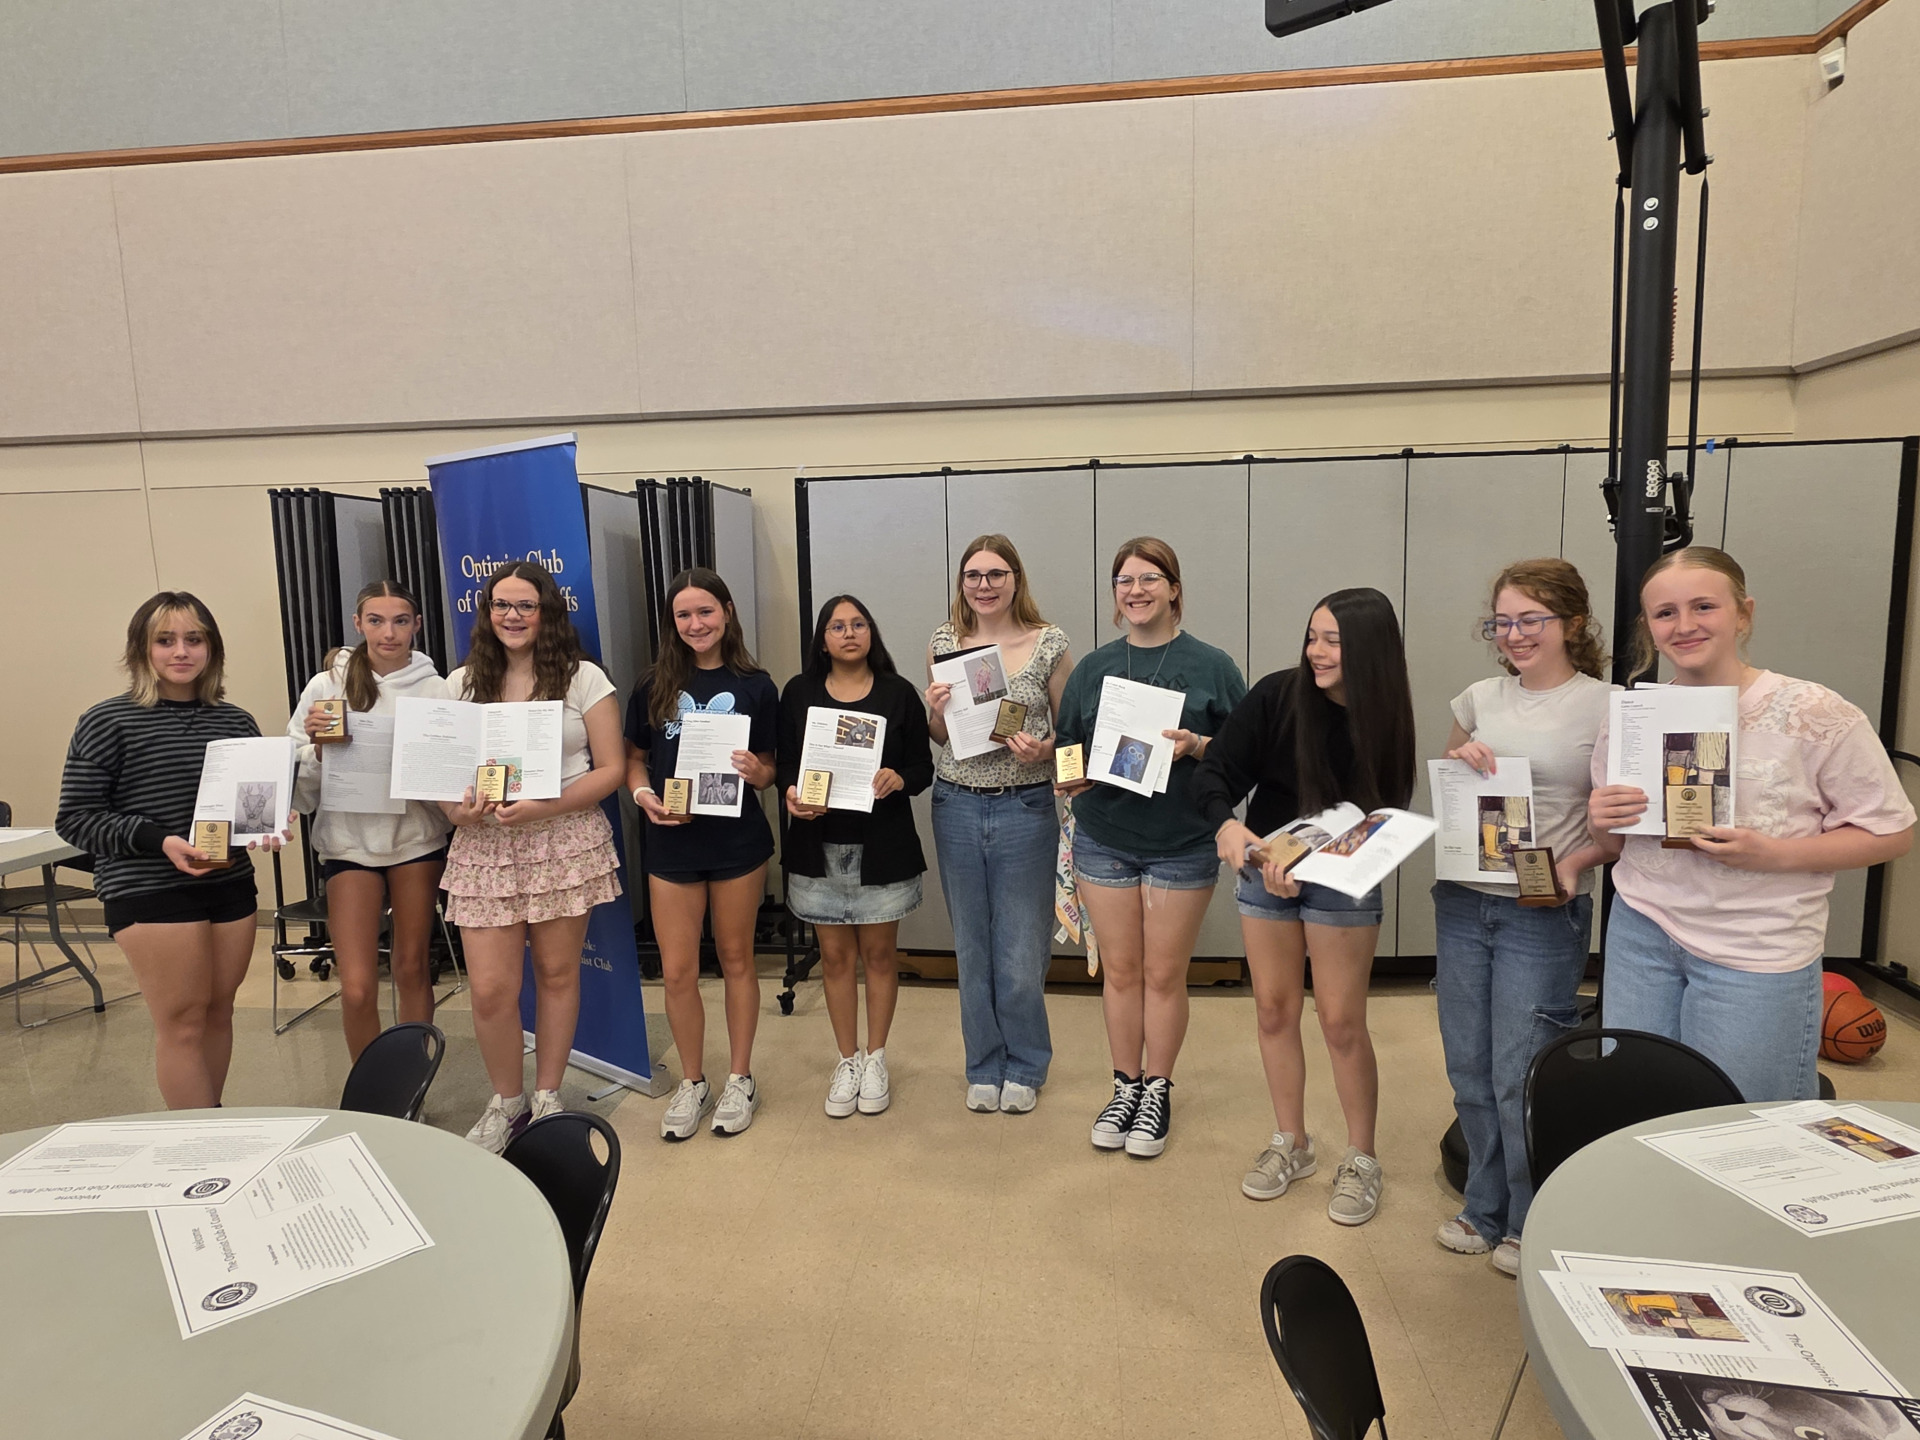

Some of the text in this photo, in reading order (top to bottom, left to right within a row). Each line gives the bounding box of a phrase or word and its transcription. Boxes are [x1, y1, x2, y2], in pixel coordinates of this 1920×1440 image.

[461, 548, 564, 583] Optim Club
[457, 589, 472, 613] of
[1063, 902, 1080, 926] IBIZA
[593, 957, 613, 972] Club
[110, 1182, 153, 1190] Optimist
[1827, 1189, 1861, 1199] Council
[209, 1207, 221, 1225] Council
[192, 1227, 206, 1251] Welcome
[214, 1228, 227, 1241] Club
[219, 1239, 237, 1262] Optimist
[227, 1260, 239, 1272] The
[1786, 1333, 1839, 1388] The Optimist
[1649, 1377, 1667, 1400] Literary
[1662, 1399, 1684, 1429] Magazine
[1658, 1411, 1678, 1438] Council
